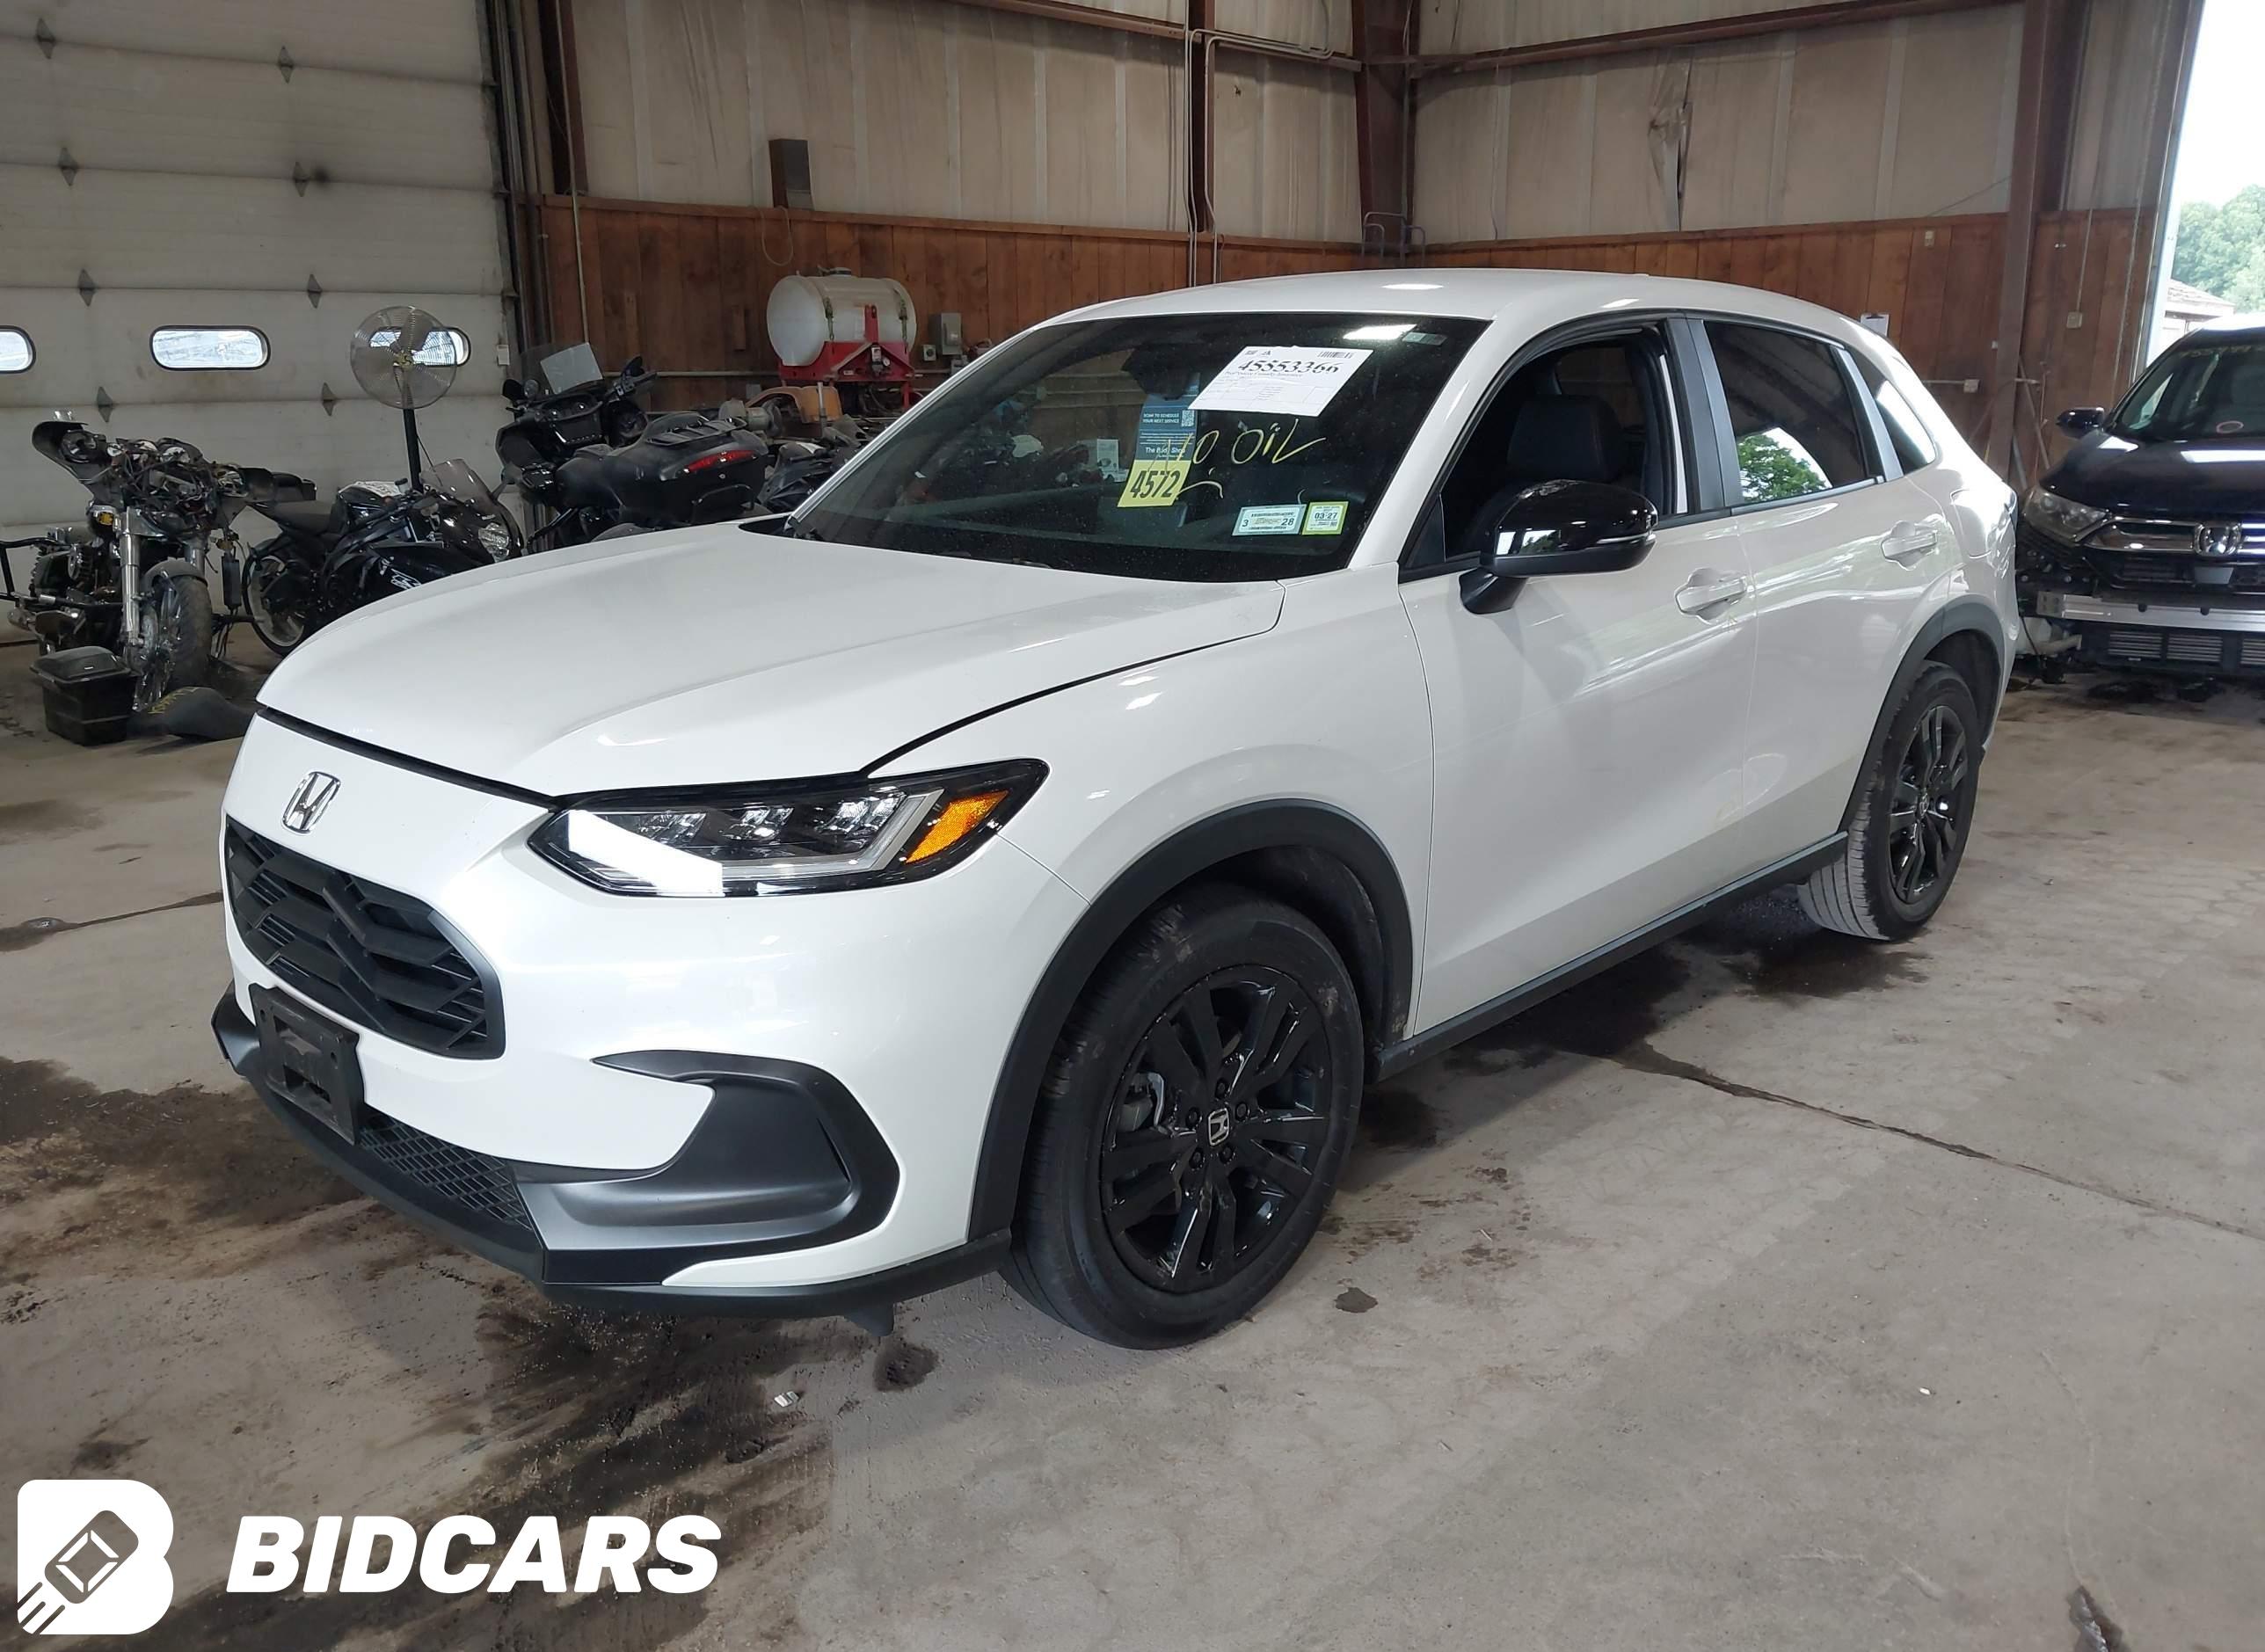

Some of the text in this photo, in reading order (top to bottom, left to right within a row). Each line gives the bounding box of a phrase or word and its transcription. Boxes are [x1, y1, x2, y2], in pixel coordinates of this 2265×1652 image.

[1238, 359, 1344, 374] 45553366
[1130, 469, 1181, 499] 4572
[1280, 518, 1295, 527] 28
